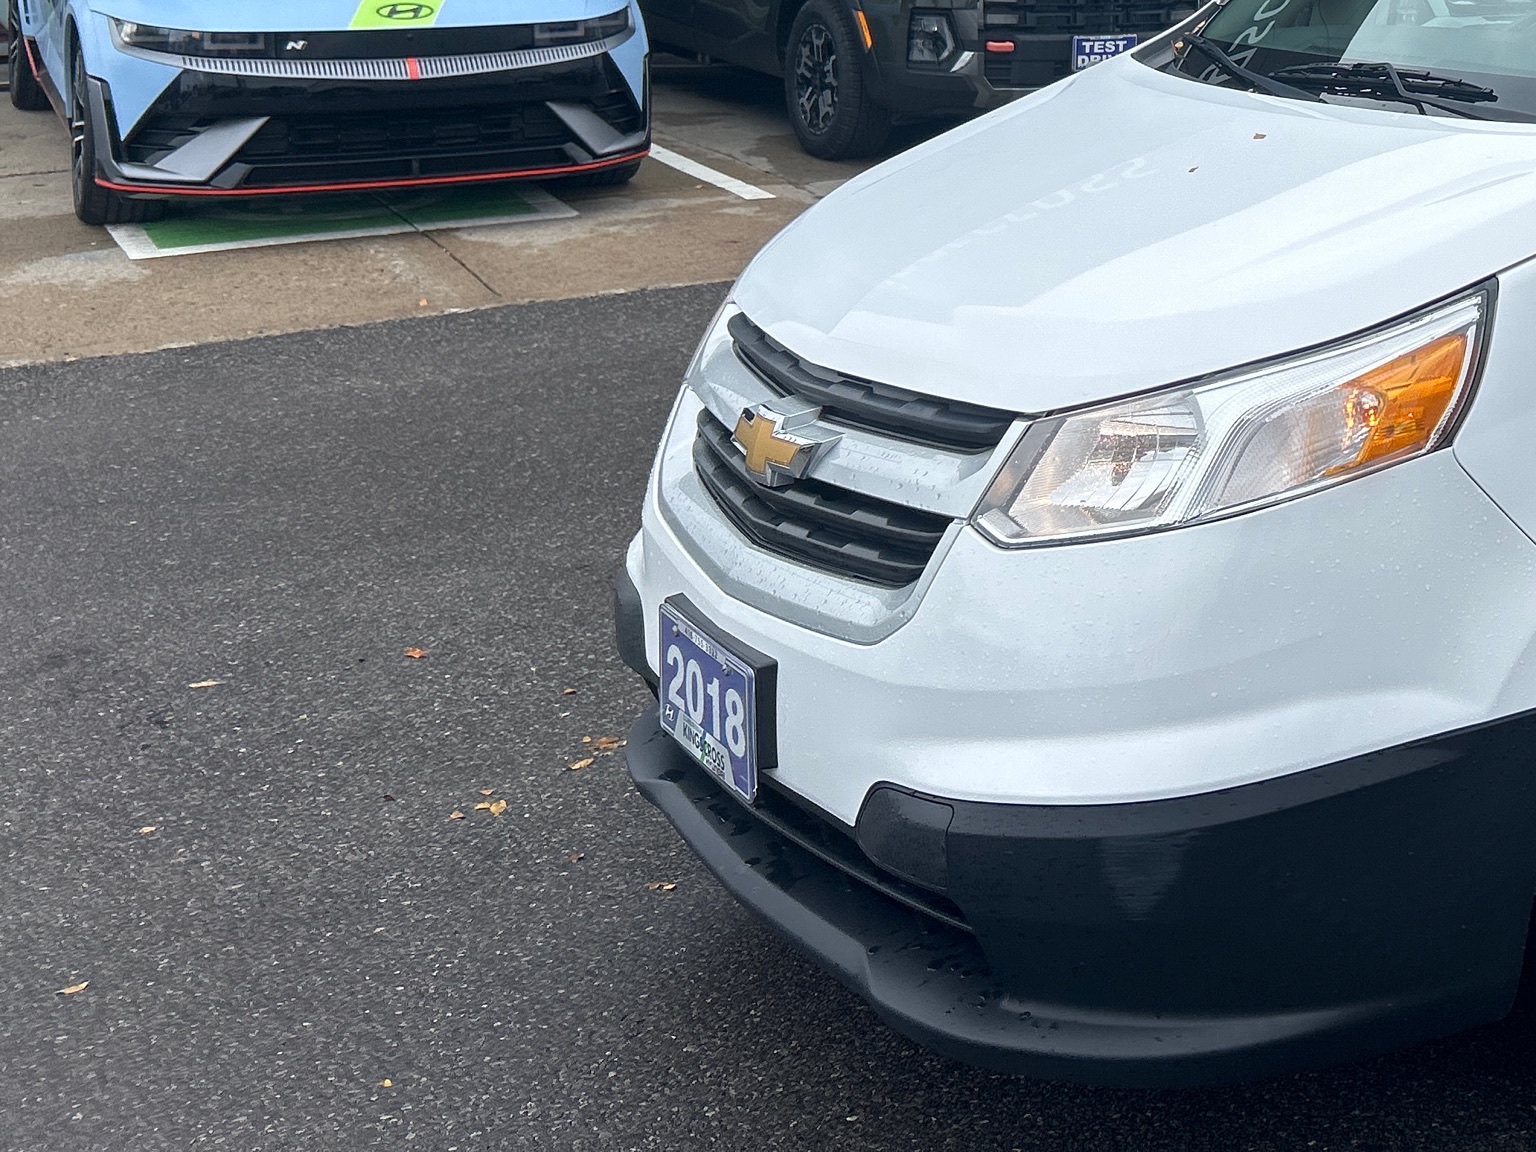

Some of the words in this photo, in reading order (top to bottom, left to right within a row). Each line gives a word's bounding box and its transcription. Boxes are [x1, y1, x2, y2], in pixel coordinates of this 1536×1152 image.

[1082, 40, 1127, 54] TEST
[666, 644, 745, 758] 2018
[682, 721, 725, 772] KINGSCROSS
